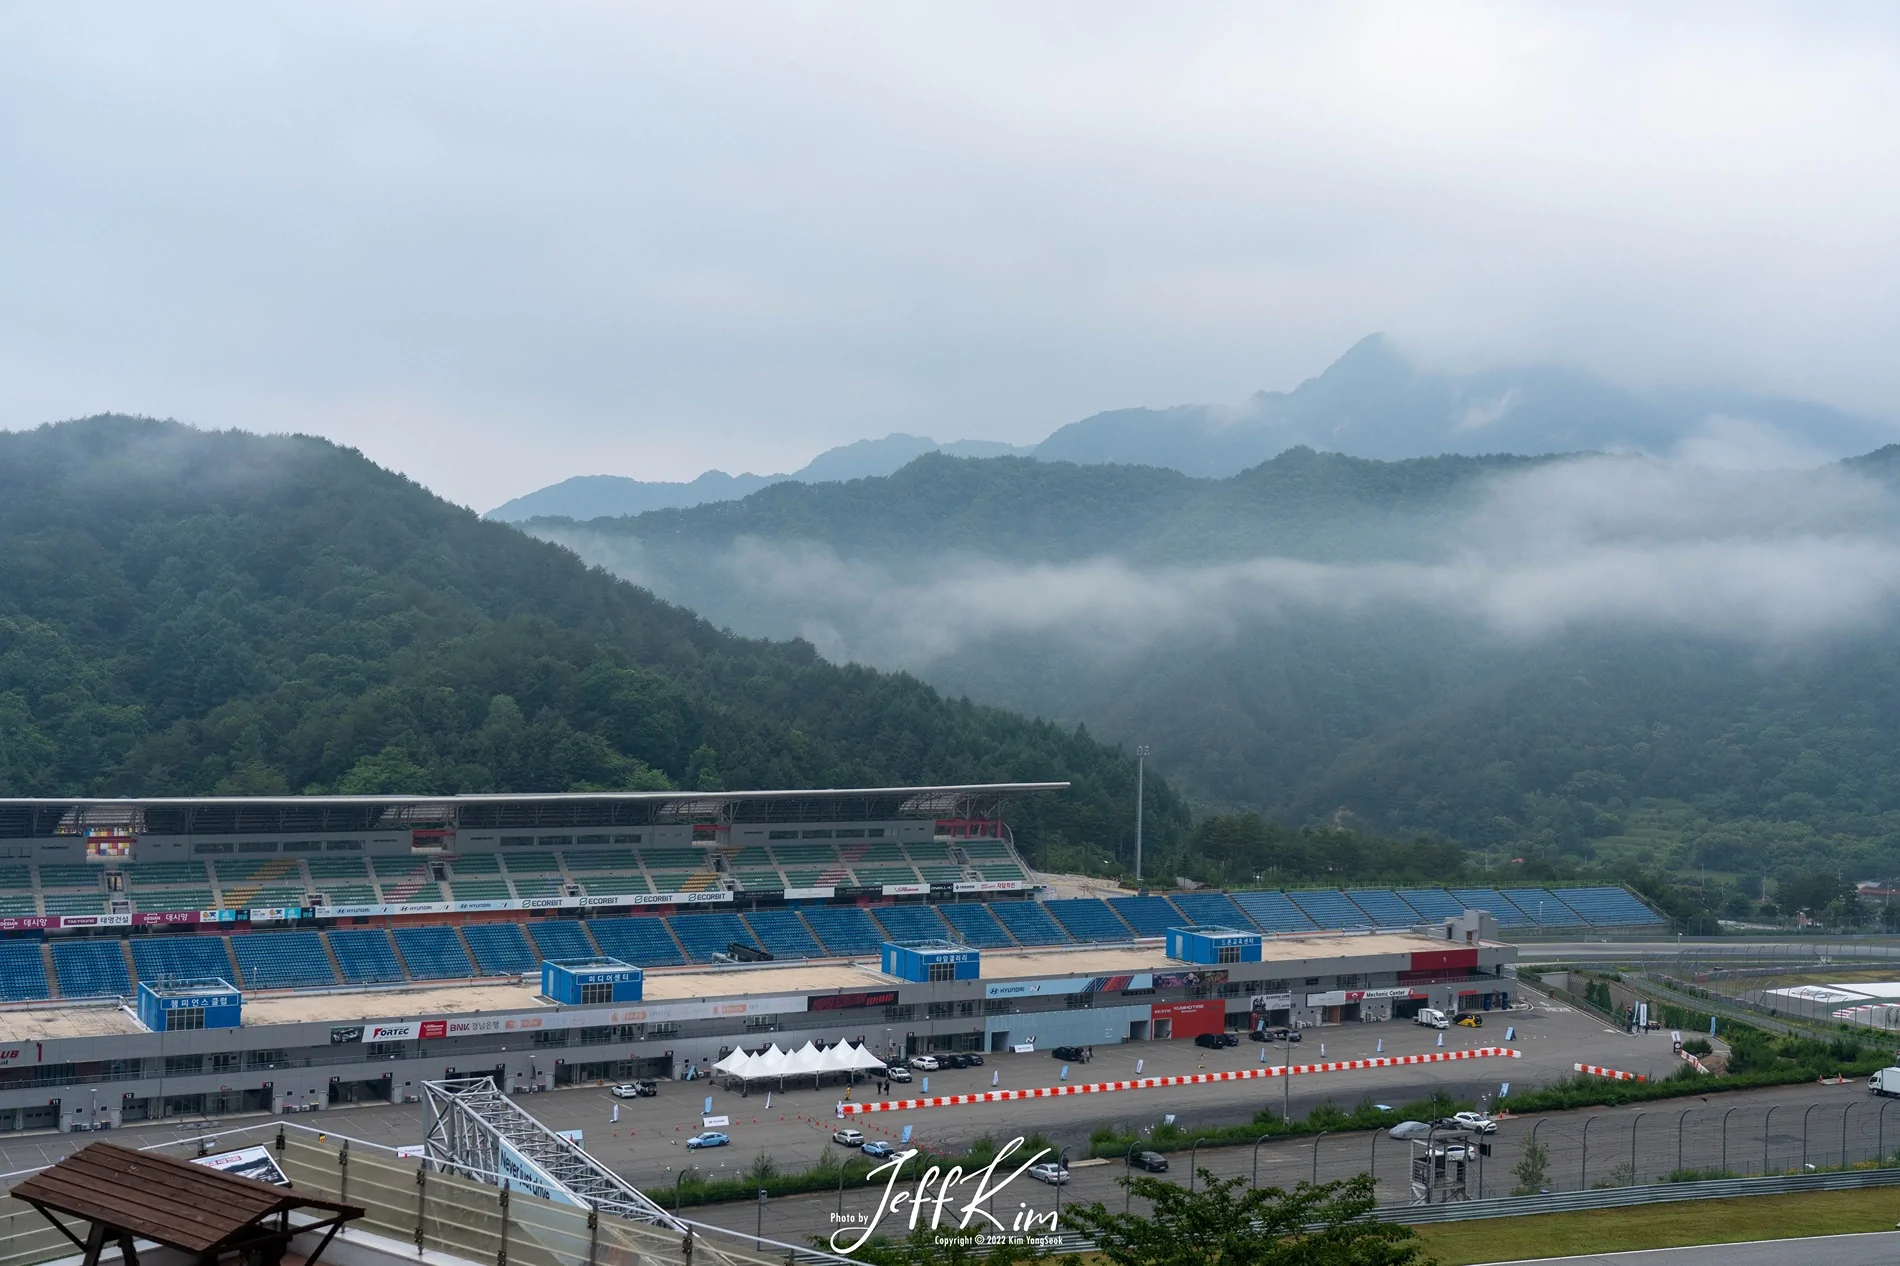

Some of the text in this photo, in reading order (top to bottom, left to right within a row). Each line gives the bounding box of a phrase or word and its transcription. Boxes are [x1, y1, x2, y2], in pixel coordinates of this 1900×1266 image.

[100, 916, 129, 924] 태영건설
[166, 913, 188, 921] 데시앙
[23, 919, 47, 927] 데시앙
[588, 973, 629, 983] 미디어센터
[1366, 990, 1388, 998] Mechanic
[170, 996, 228, 1008] 챔피언스클럽
[450, 1023, 470, 1032] BNK
[471, 1021, 500, 1031] 경남은행
[373, 1027, 409, 1039] FORTEC
[501, 1149, 550, 1200] Never just drive
